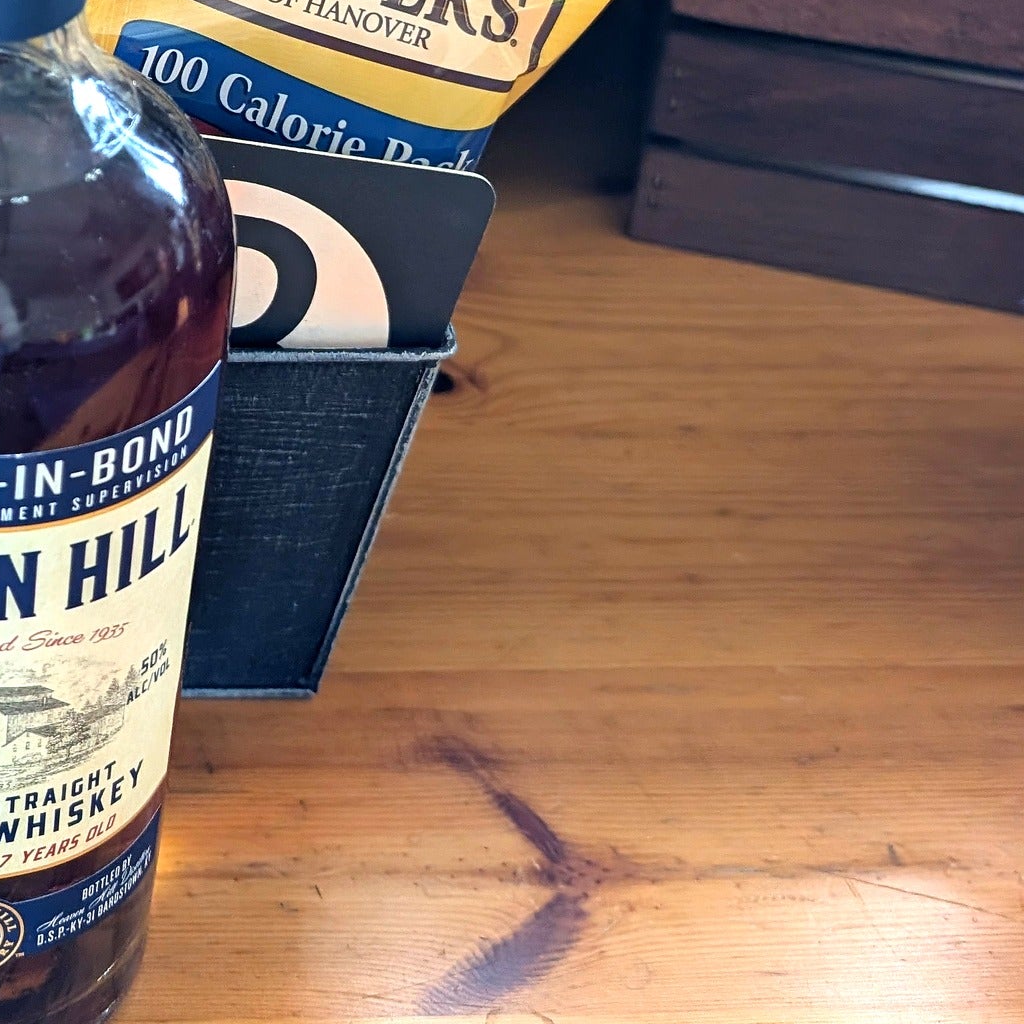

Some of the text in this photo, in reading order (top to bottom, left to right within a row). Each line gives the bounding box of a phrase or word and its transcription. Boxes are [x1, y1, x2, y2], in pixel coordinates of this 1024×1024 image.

[141, 45, 209, 93] 100
[218, 73, 367, 155] Calorie
[72, 444, 188, 512] SUPERVISION
[65, 483, 196, 612] HILL
[22, 629, 85, 652] Since
[89, 622, 130, 644] 1935
[140, 638, 168, 676] 50%
[126, 657, 170, 705] ALC/VOL
[22, 832, 80, 865] YEARS
[85, 813, 117, 843] OLD
[81, 853, 133, 901] BOTTLED BY
